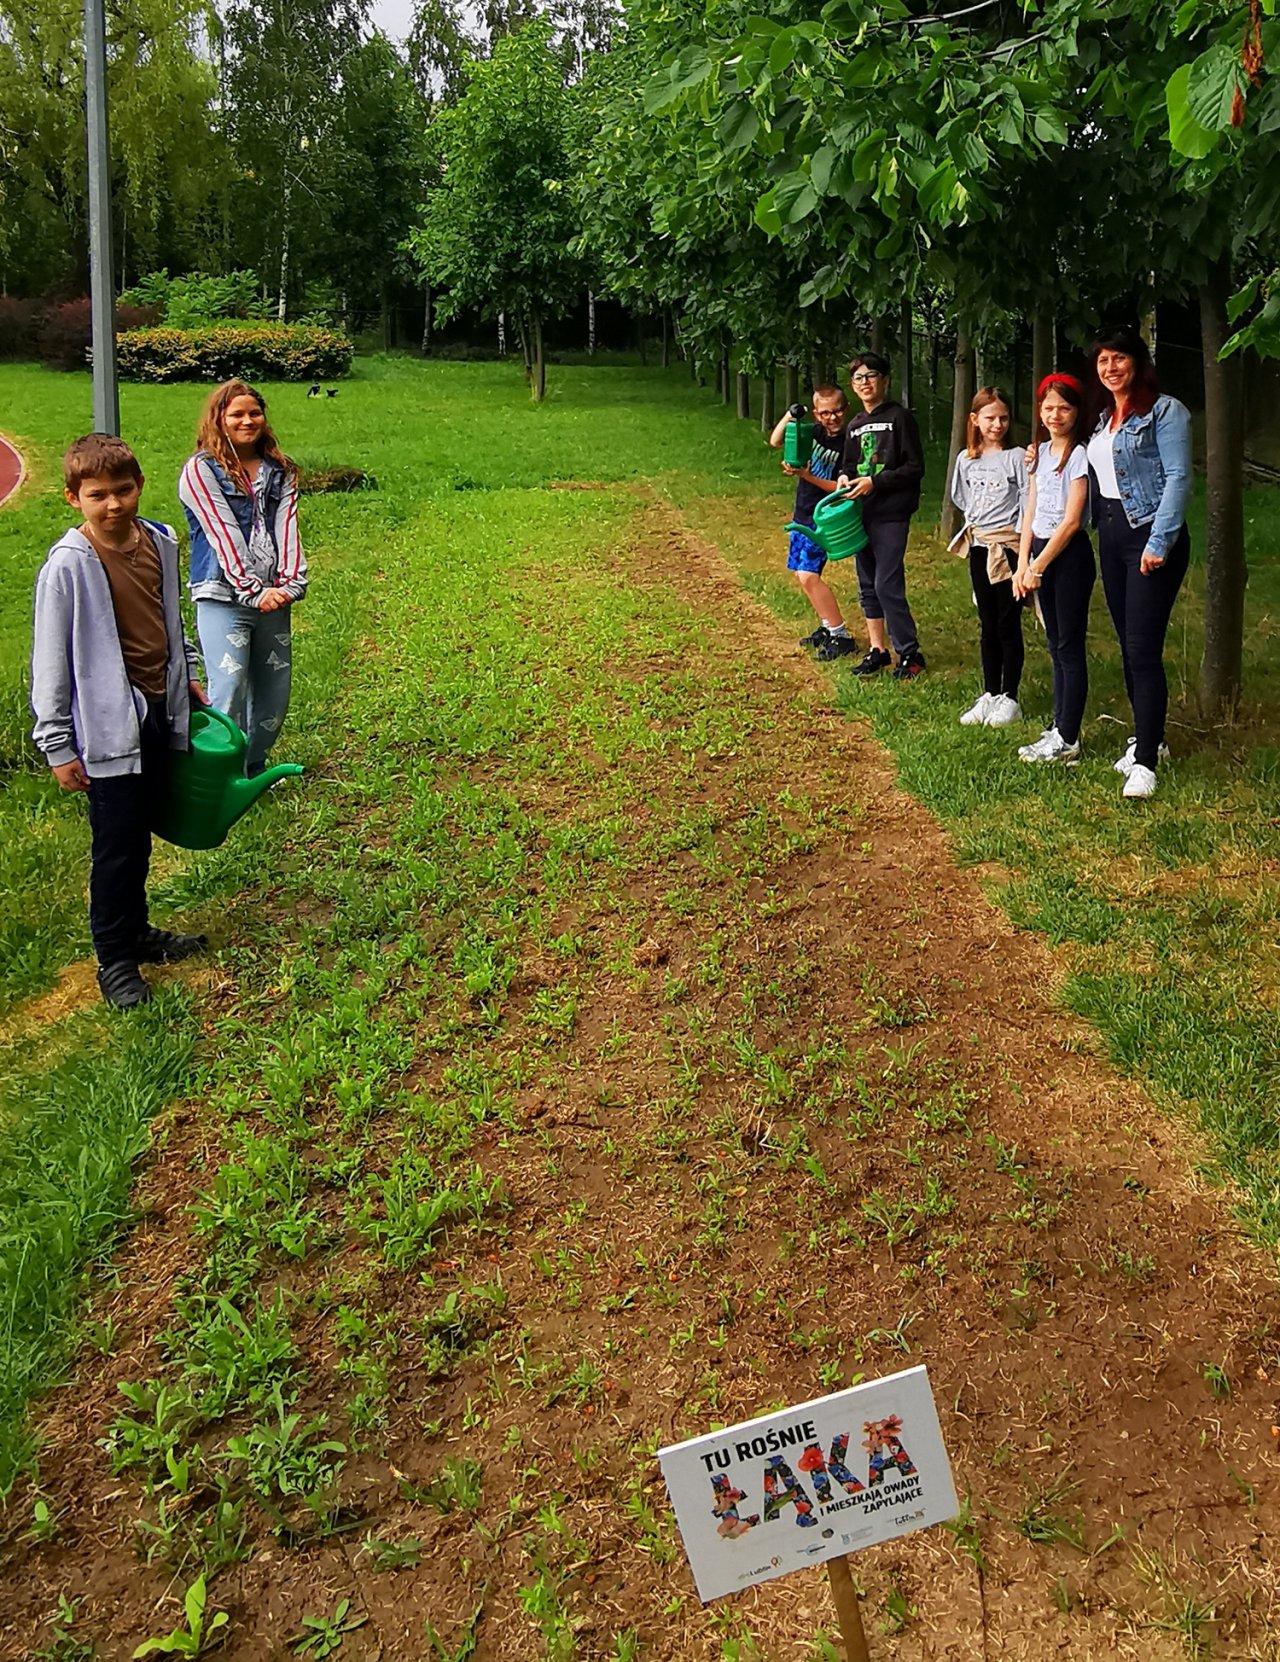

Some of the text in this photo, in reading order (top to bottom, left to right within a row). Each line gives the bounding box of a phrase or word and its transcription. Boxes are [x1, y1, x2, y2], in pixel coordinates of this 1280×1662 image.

[700, 1420, 818, 1472] TU ROŚNIE
[709, 1414, 918, 1540] ŁĄKA
[819, 1475, 920, 1517] I MIESZKAJĄ OWADY
[862, 1487, 924, 1515] ZAPYLAJĄCE
